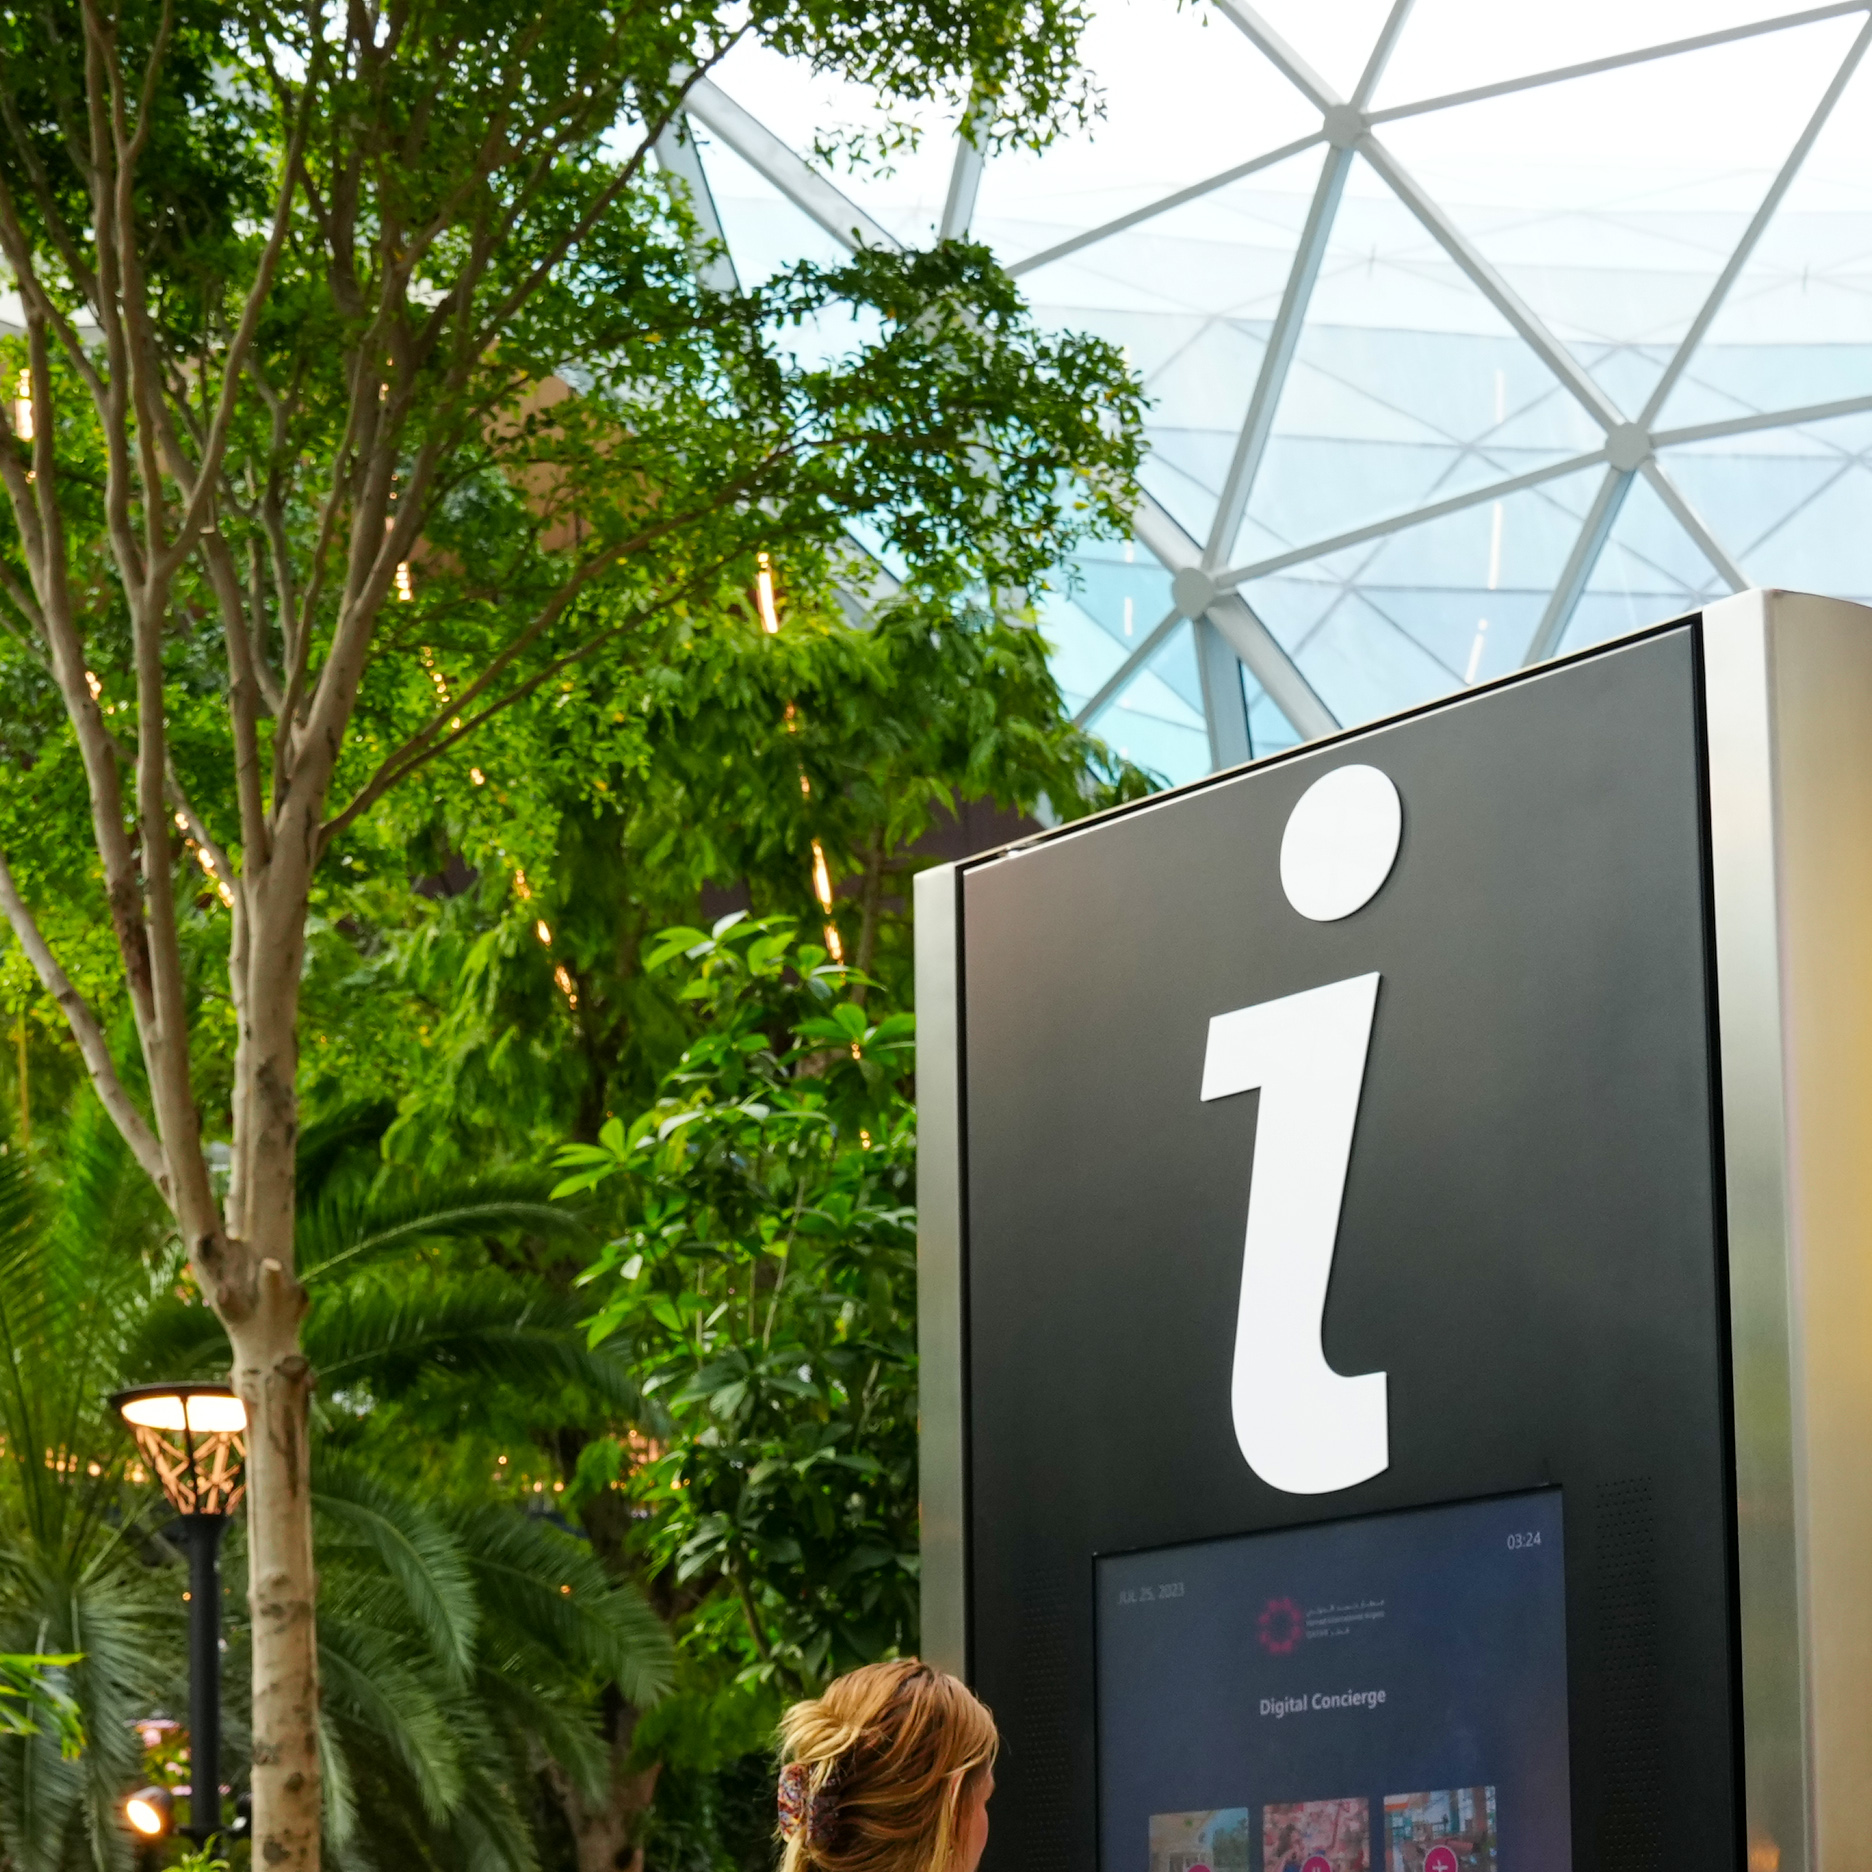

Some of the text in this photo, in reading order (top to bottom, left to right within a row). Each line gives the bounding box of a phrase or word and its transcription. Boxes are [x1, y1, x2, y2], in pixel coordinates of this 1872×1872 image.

[1200, 763, 1403, 1495] i
[1507, 1531, 1542, 1550] 03:24
[1260, 1689, 1386, 1719] Digital Concierge
